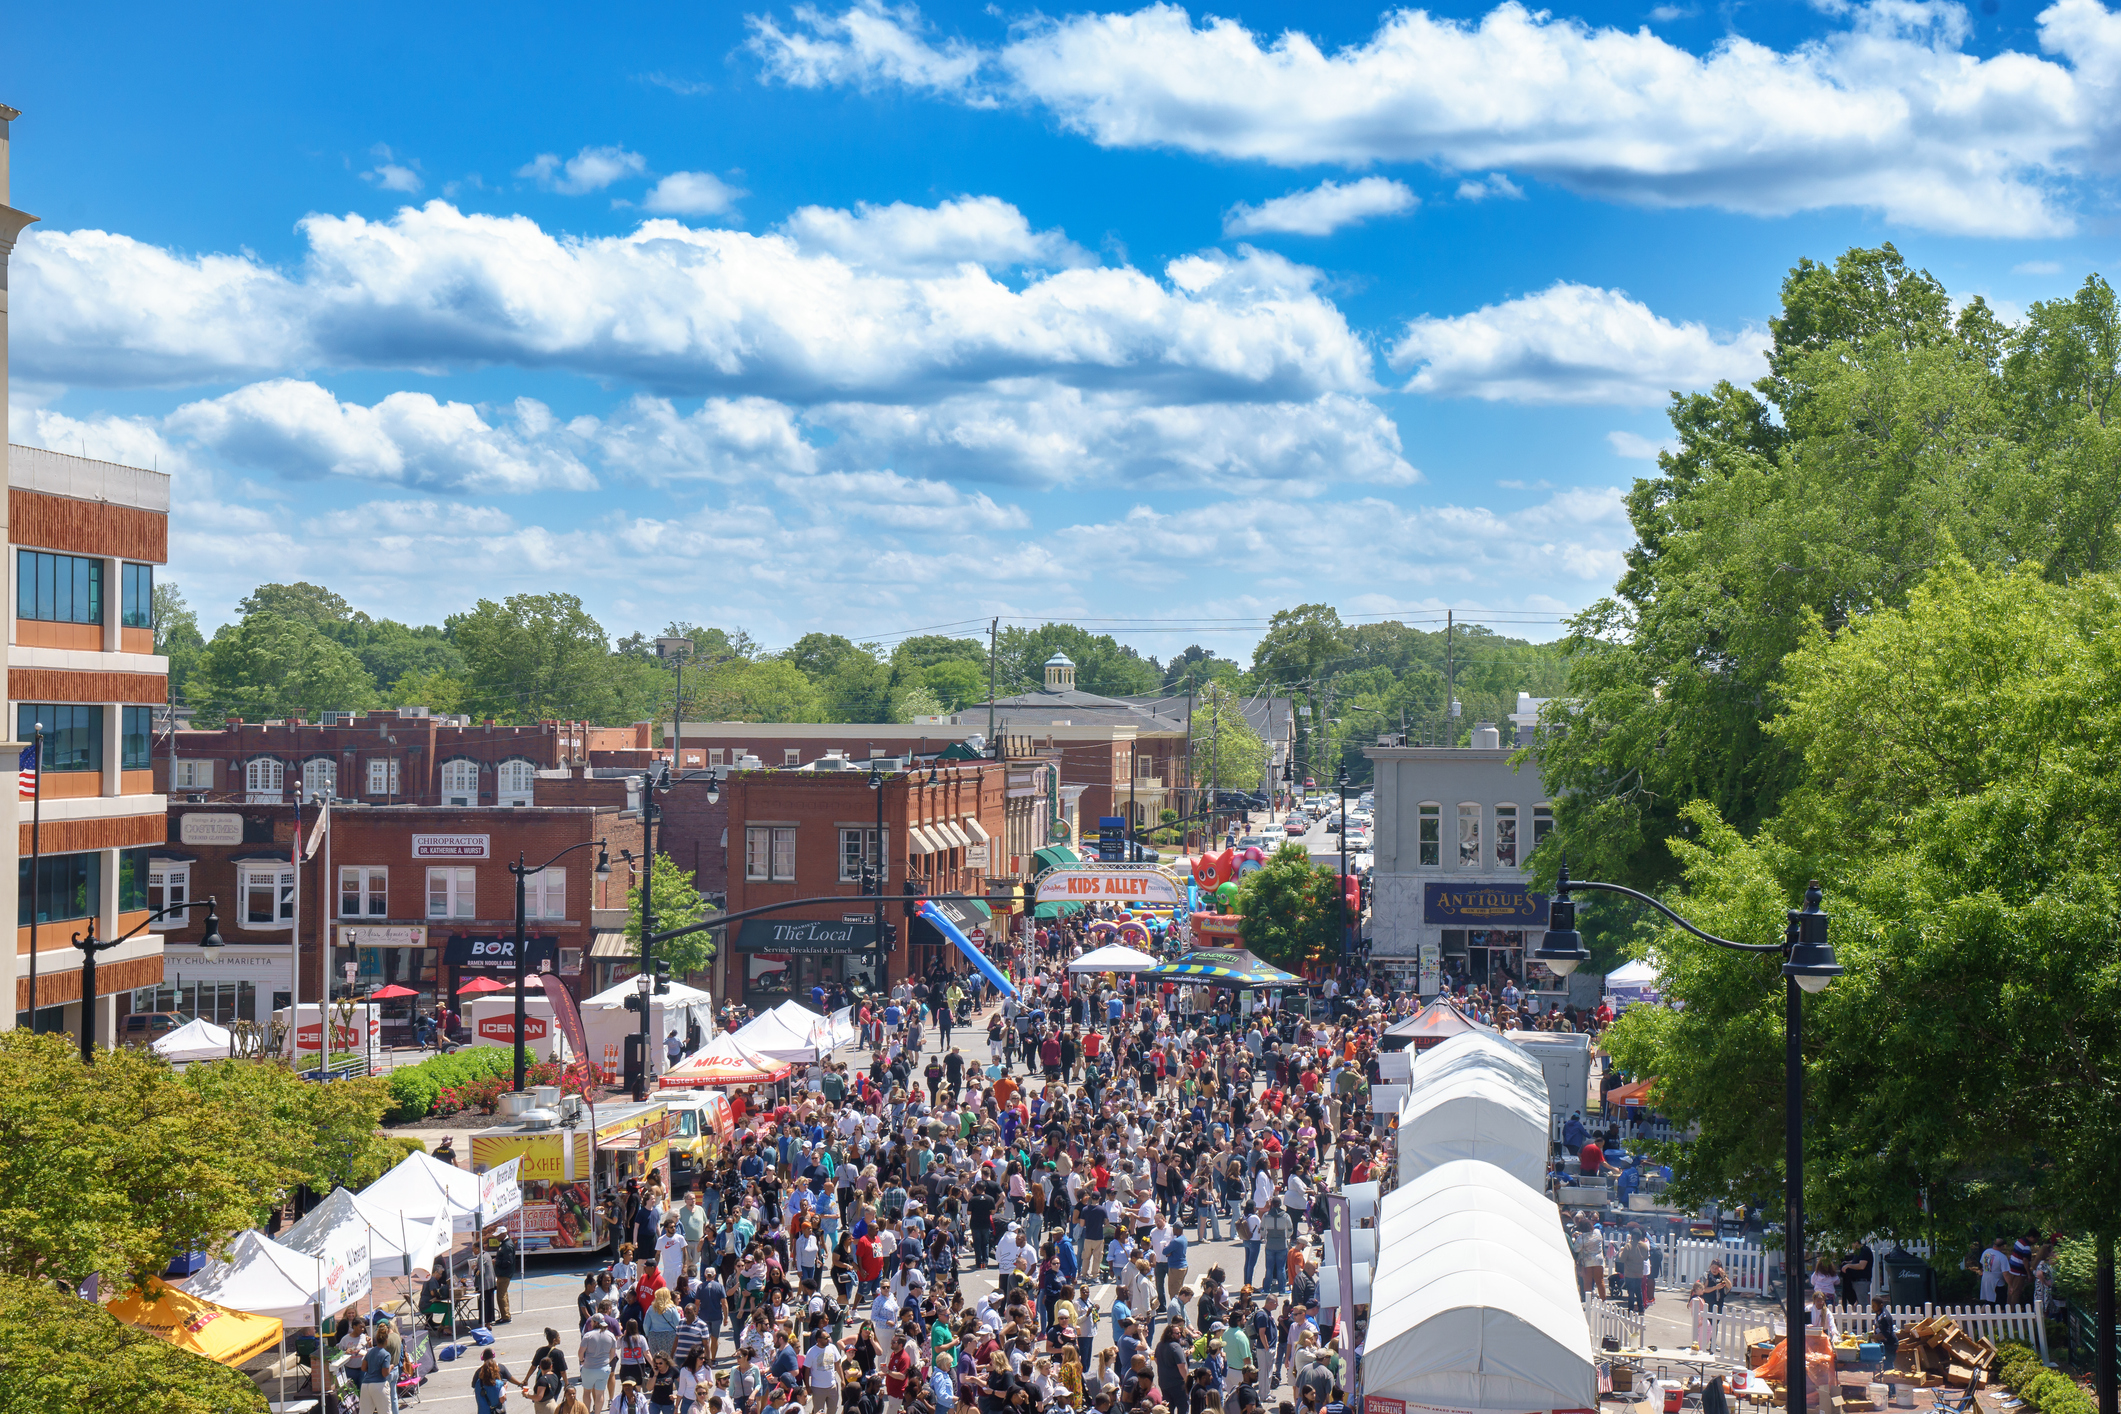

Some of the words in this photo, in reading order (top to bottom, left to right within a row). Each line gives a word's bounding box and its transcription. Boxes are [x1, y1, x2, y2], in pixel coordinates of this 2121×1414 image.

[184, 824, 240, 834] COSTUMES
[417, 837, 484, 845] CHIROPRACTOR
[1067, 877, 1100, 894] KIDS
[1104, 878, 1149, 895] ALLEY
[1437, 892, 1537, 915] ANTIQUES
[792, 921, 821, 930] MARIETTA
[773, 925, 804, 940] The
[807, 926, 854, 941] Local
[763, 946, 789, 954] Serving
[790, 946, 822, 954] Breakfast
[163, 957, 181, 965] CITY
[185, 957, 224, 965] CHURCH
[1198, 952, 1240, 963] ANDRETTI
[1411, 1037, 1430, 1045] RED
[665, 1077, 695, 1085] Tastes
[719, 1073, 770, 1082] Homemade
[536, 1158, 561, 1171] CHEF
[527, 1211, 554, 1220] CATER
[623, 1347, 642, 1359] 23
[1369, 1404, 1403, 1414] CATERING
